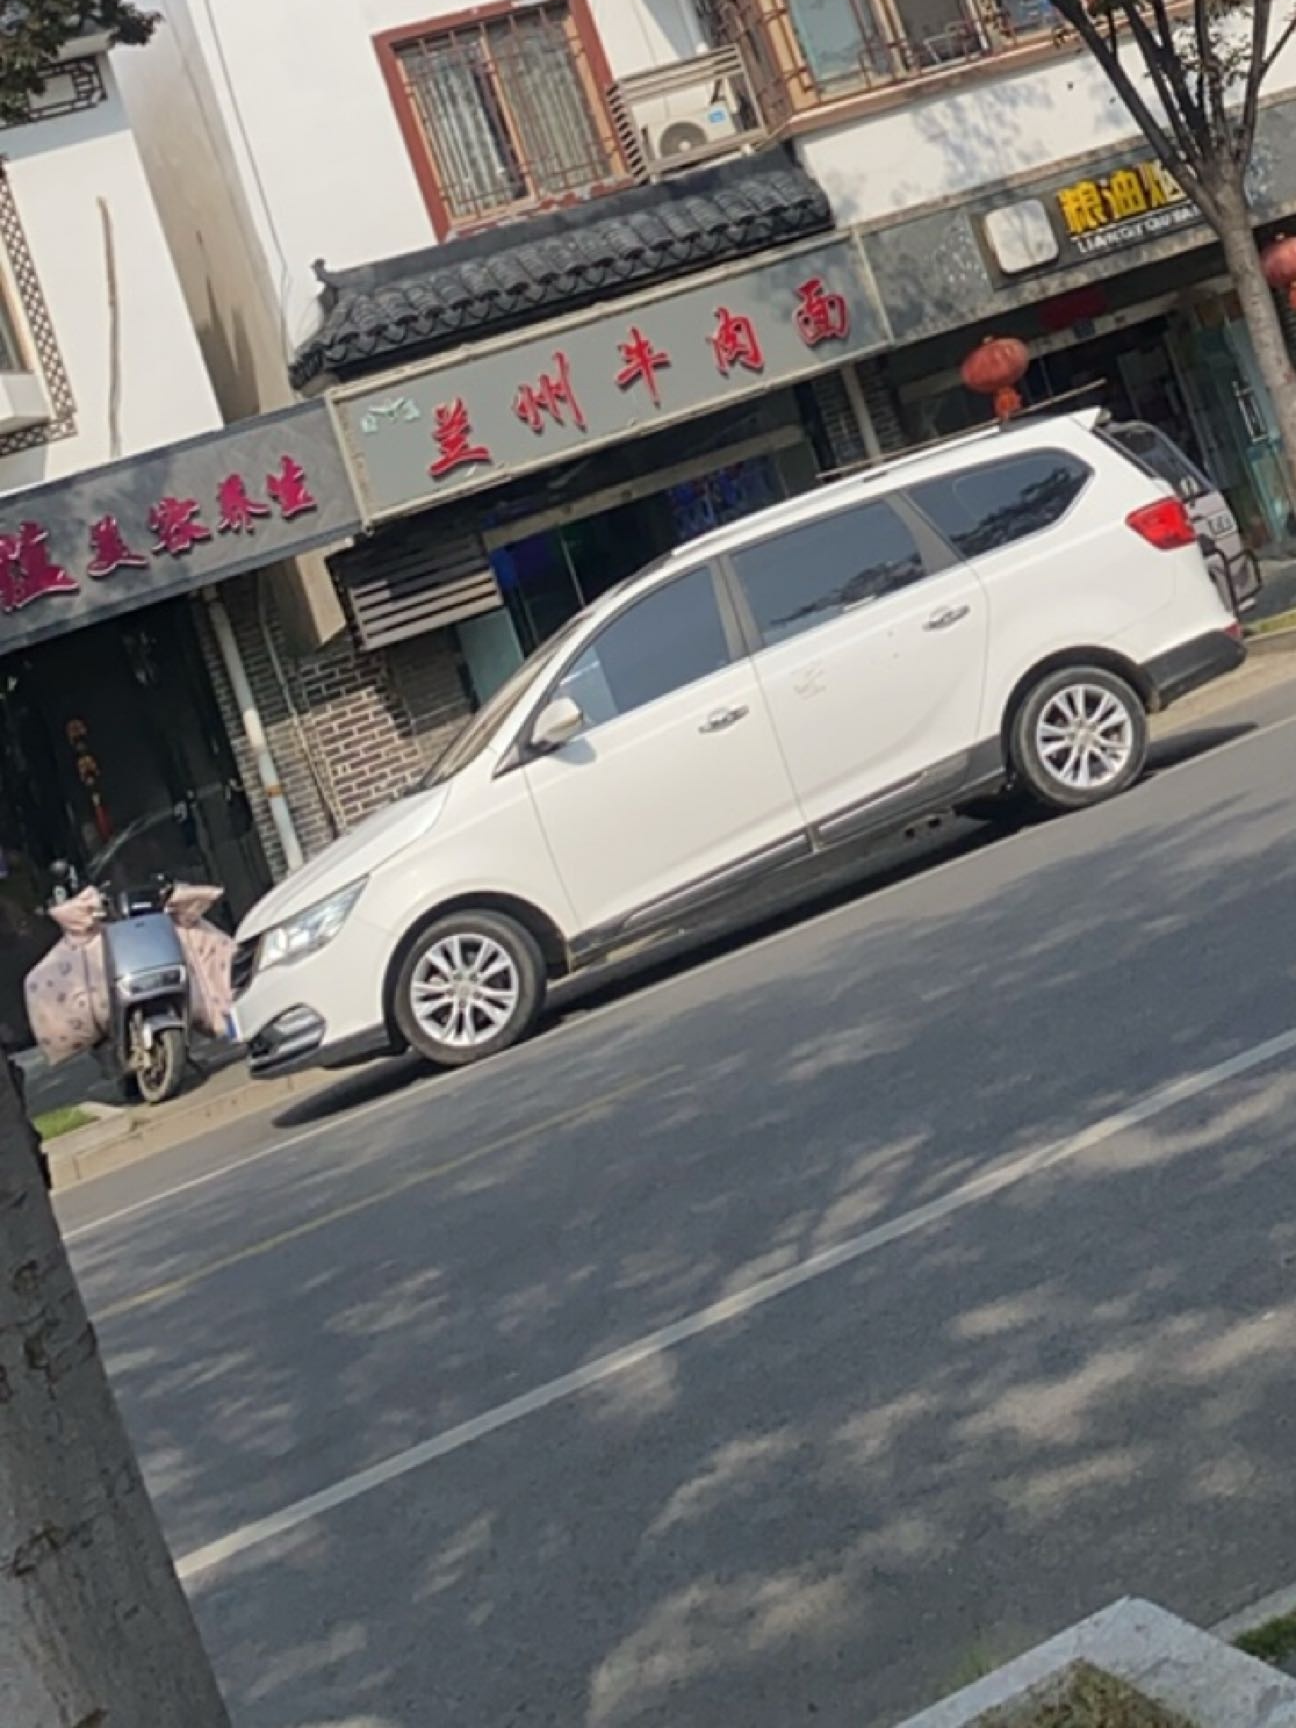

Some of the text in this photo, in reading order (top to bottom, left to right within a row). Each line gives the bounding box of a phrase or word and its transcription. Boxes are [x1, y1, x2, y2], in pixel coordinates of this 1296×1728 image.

[430, 275, 852, 479] 兰州牛肉面
